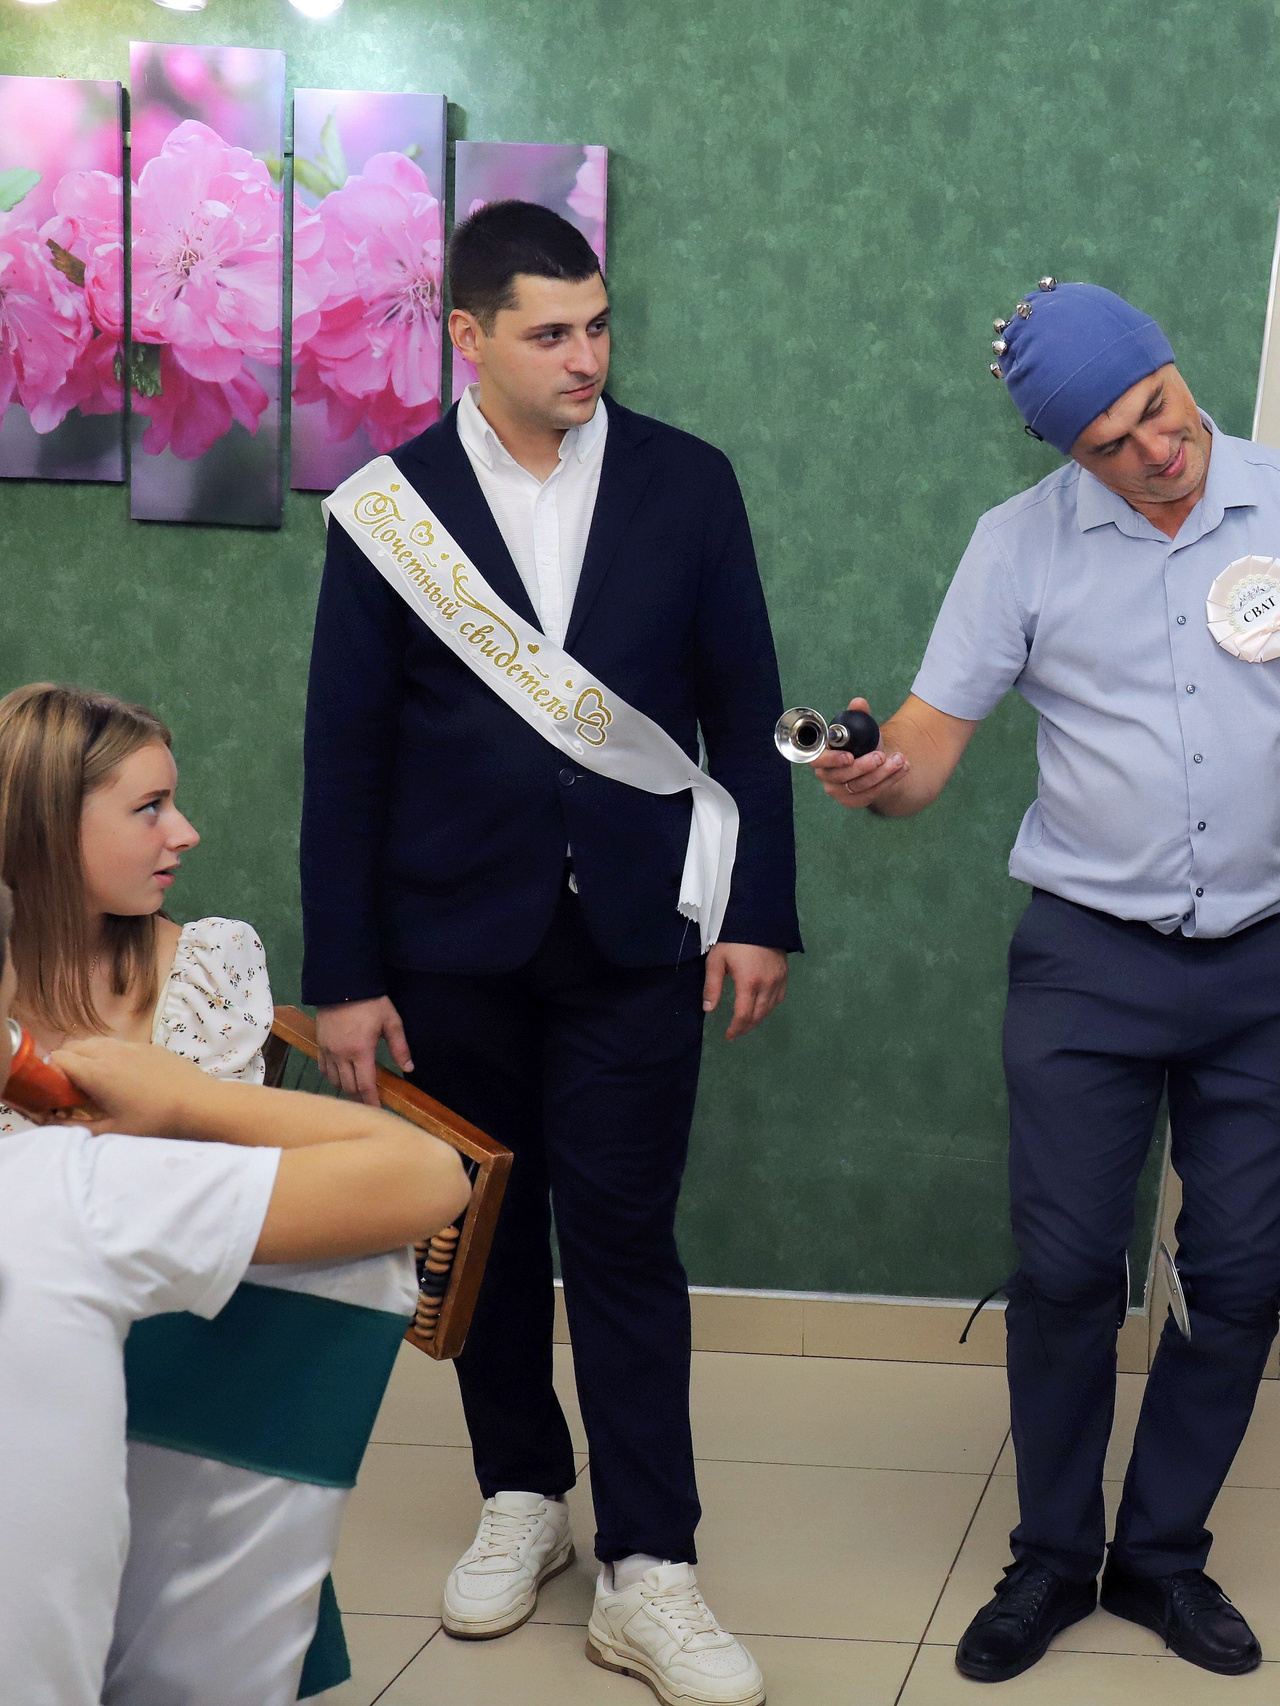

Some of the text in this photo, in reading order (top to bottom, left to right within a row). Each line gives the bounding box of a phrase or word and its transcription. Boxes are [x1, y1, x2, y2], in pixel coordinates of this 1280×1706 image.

[353, 491, 569, 722] Почетный свидетель
[1243, 595, 1276, 623] СВАТ
